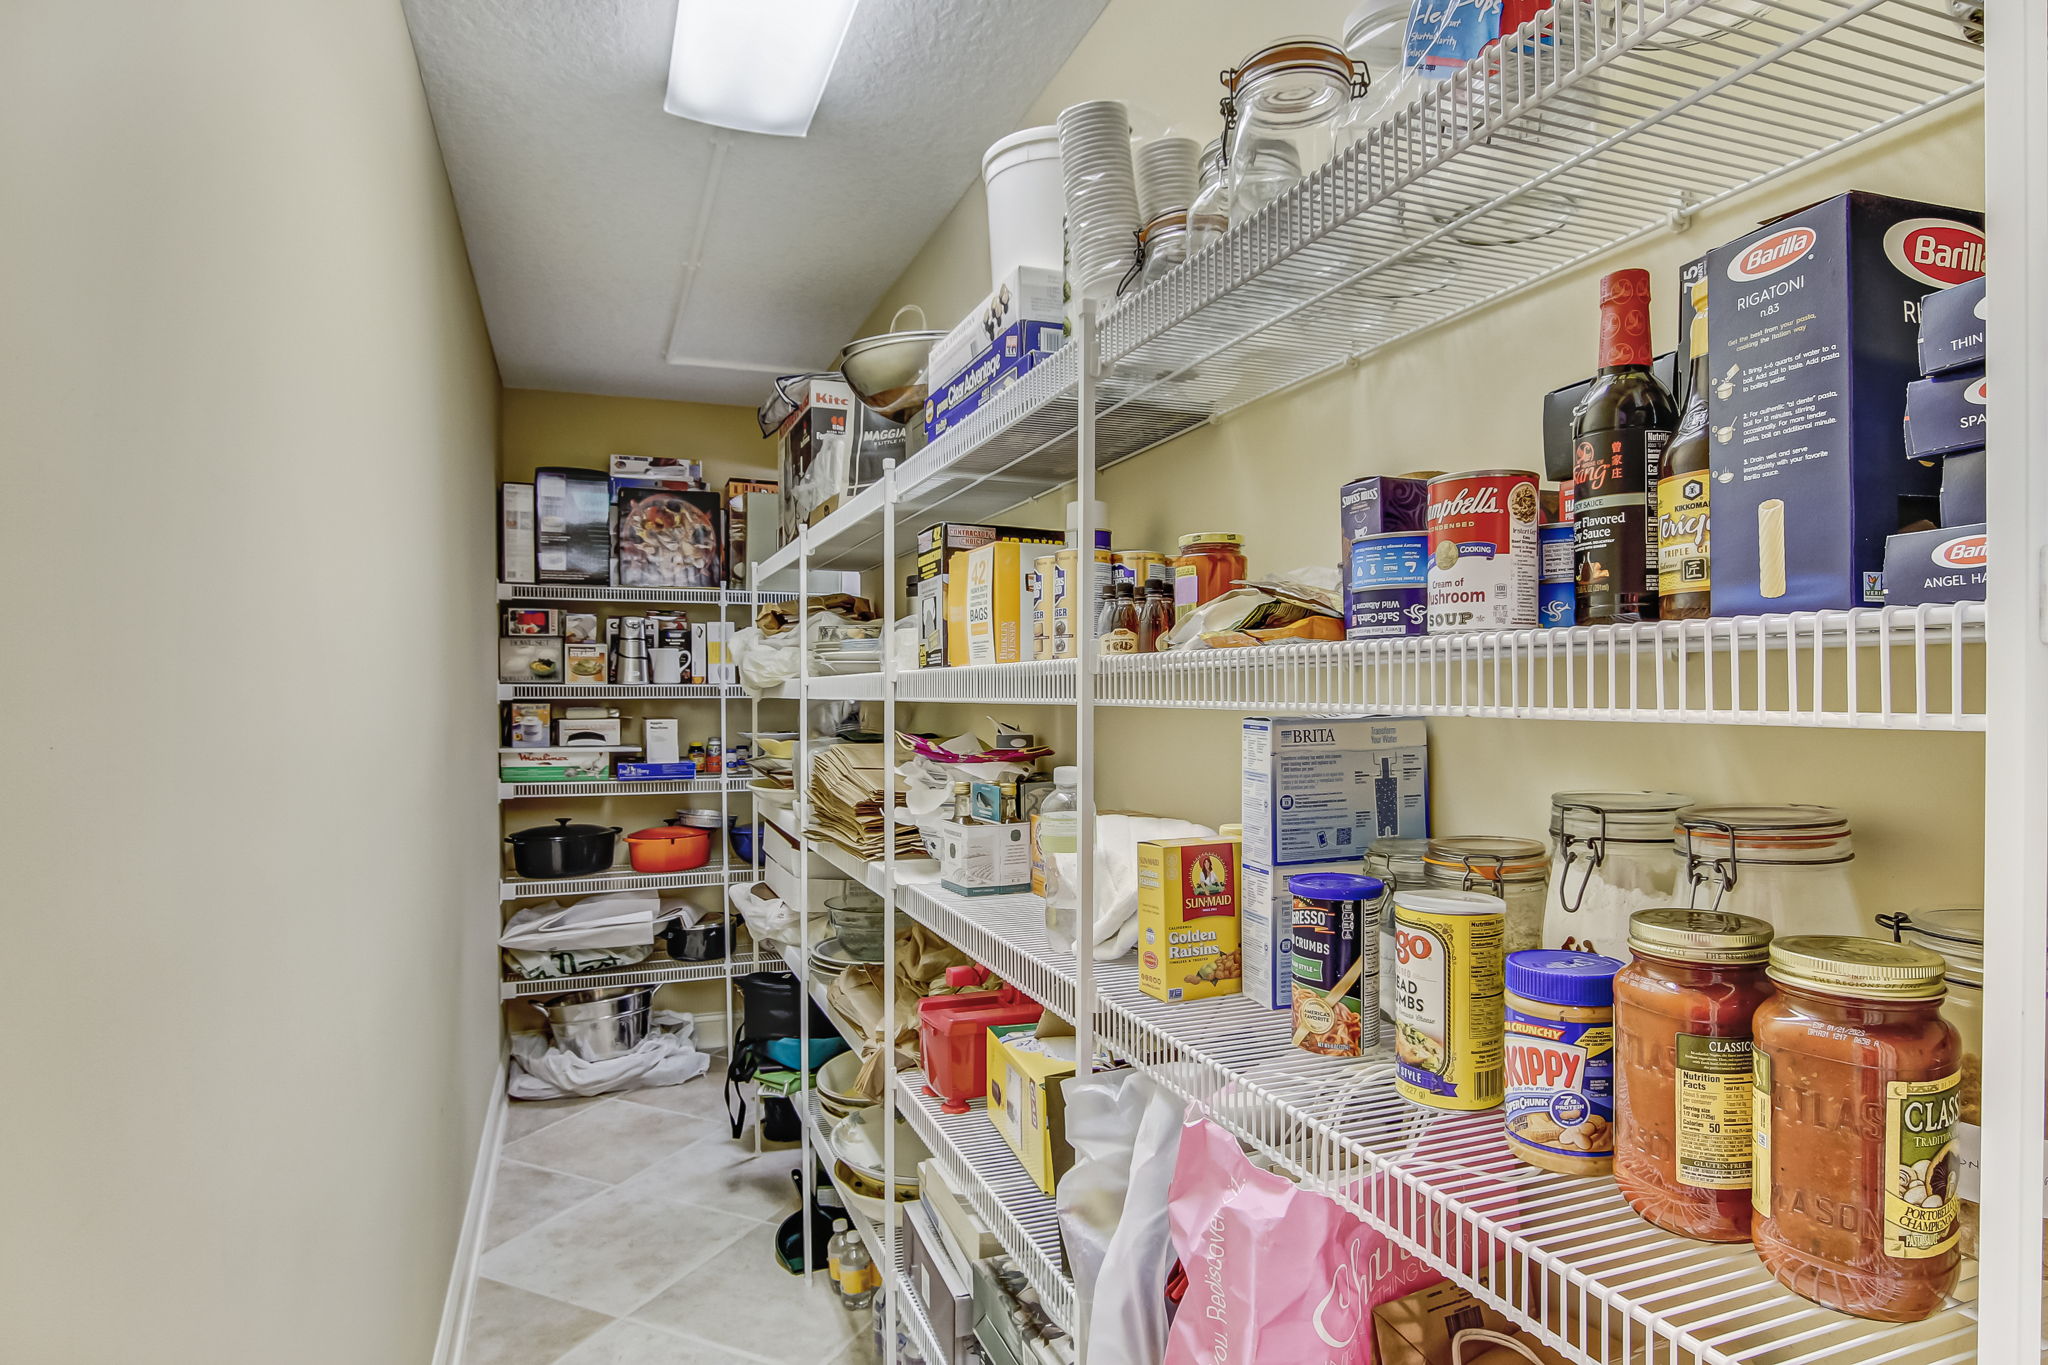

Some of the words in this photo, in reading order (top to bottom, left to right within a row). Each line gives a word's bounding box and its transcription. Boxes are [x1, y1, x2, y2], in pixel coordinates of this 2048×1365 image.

[1746, 233, 1809, 272] Barilla
[1737, 275, 1805, 311] RIGATONI
[1760, 303, 1780, 318] n.83
[1950, 332, 1984, 352] THIN
[1803, 348, 1821, 358] water
[1806, 356, 1820, 366] Add
[1821, 351, 1840, 362] pasta
[1428, 487, 1500, 523] ampbell's
[1582, 511, 1626, 527] Flavored
[1583, 527, 1611, 541] Sauce
[1460, 545, 1492, 554] COOKING
[1664, 546, 1690, 558] TRIPLE
[971, 560, 987, 586] 42
[1432, 580, 1453, 590] Cream
[1454, 577, 1465, 587] of
[1924, 573, 1967, 589] ANGEL
[1428, 589, 1486, 606] ushroom
[970, 607, 988, 622] BAGS
[1377, 611, 1400, 624] Safe
[1429, 611, 1474, 628] SOUP
[1293, 728, 1336, 743] BRITA
[1168, 930, 1217, 945] Golden
[1169, 943, 1221, 959] Raisins
[1296, 938, 1330, 956] CRUMBS
[1704, 952, 1723, 960] THE
[1835, 978, 1882, 989] REGIONS
[1512, 1022, 1562, 1041] CRUNCHY
[1401, 1067, 1422, 1084] STYLE
[1683, 1071, 1721, 1083] Nutrition
[1683, 1079, 1706, 1091] Facts
[1683, 1104, 1700, 1113] Serving
[1905, 1090, 1961, 1133] CLASS
[1683, 1118, 1704, 1128] Calories
[1709, 1123, 1721, 1134] 50
[1693, 1160, 1746, 1169] GLUTEN-FREE
[1205, 1206, 1228, 1325] Rediscover
